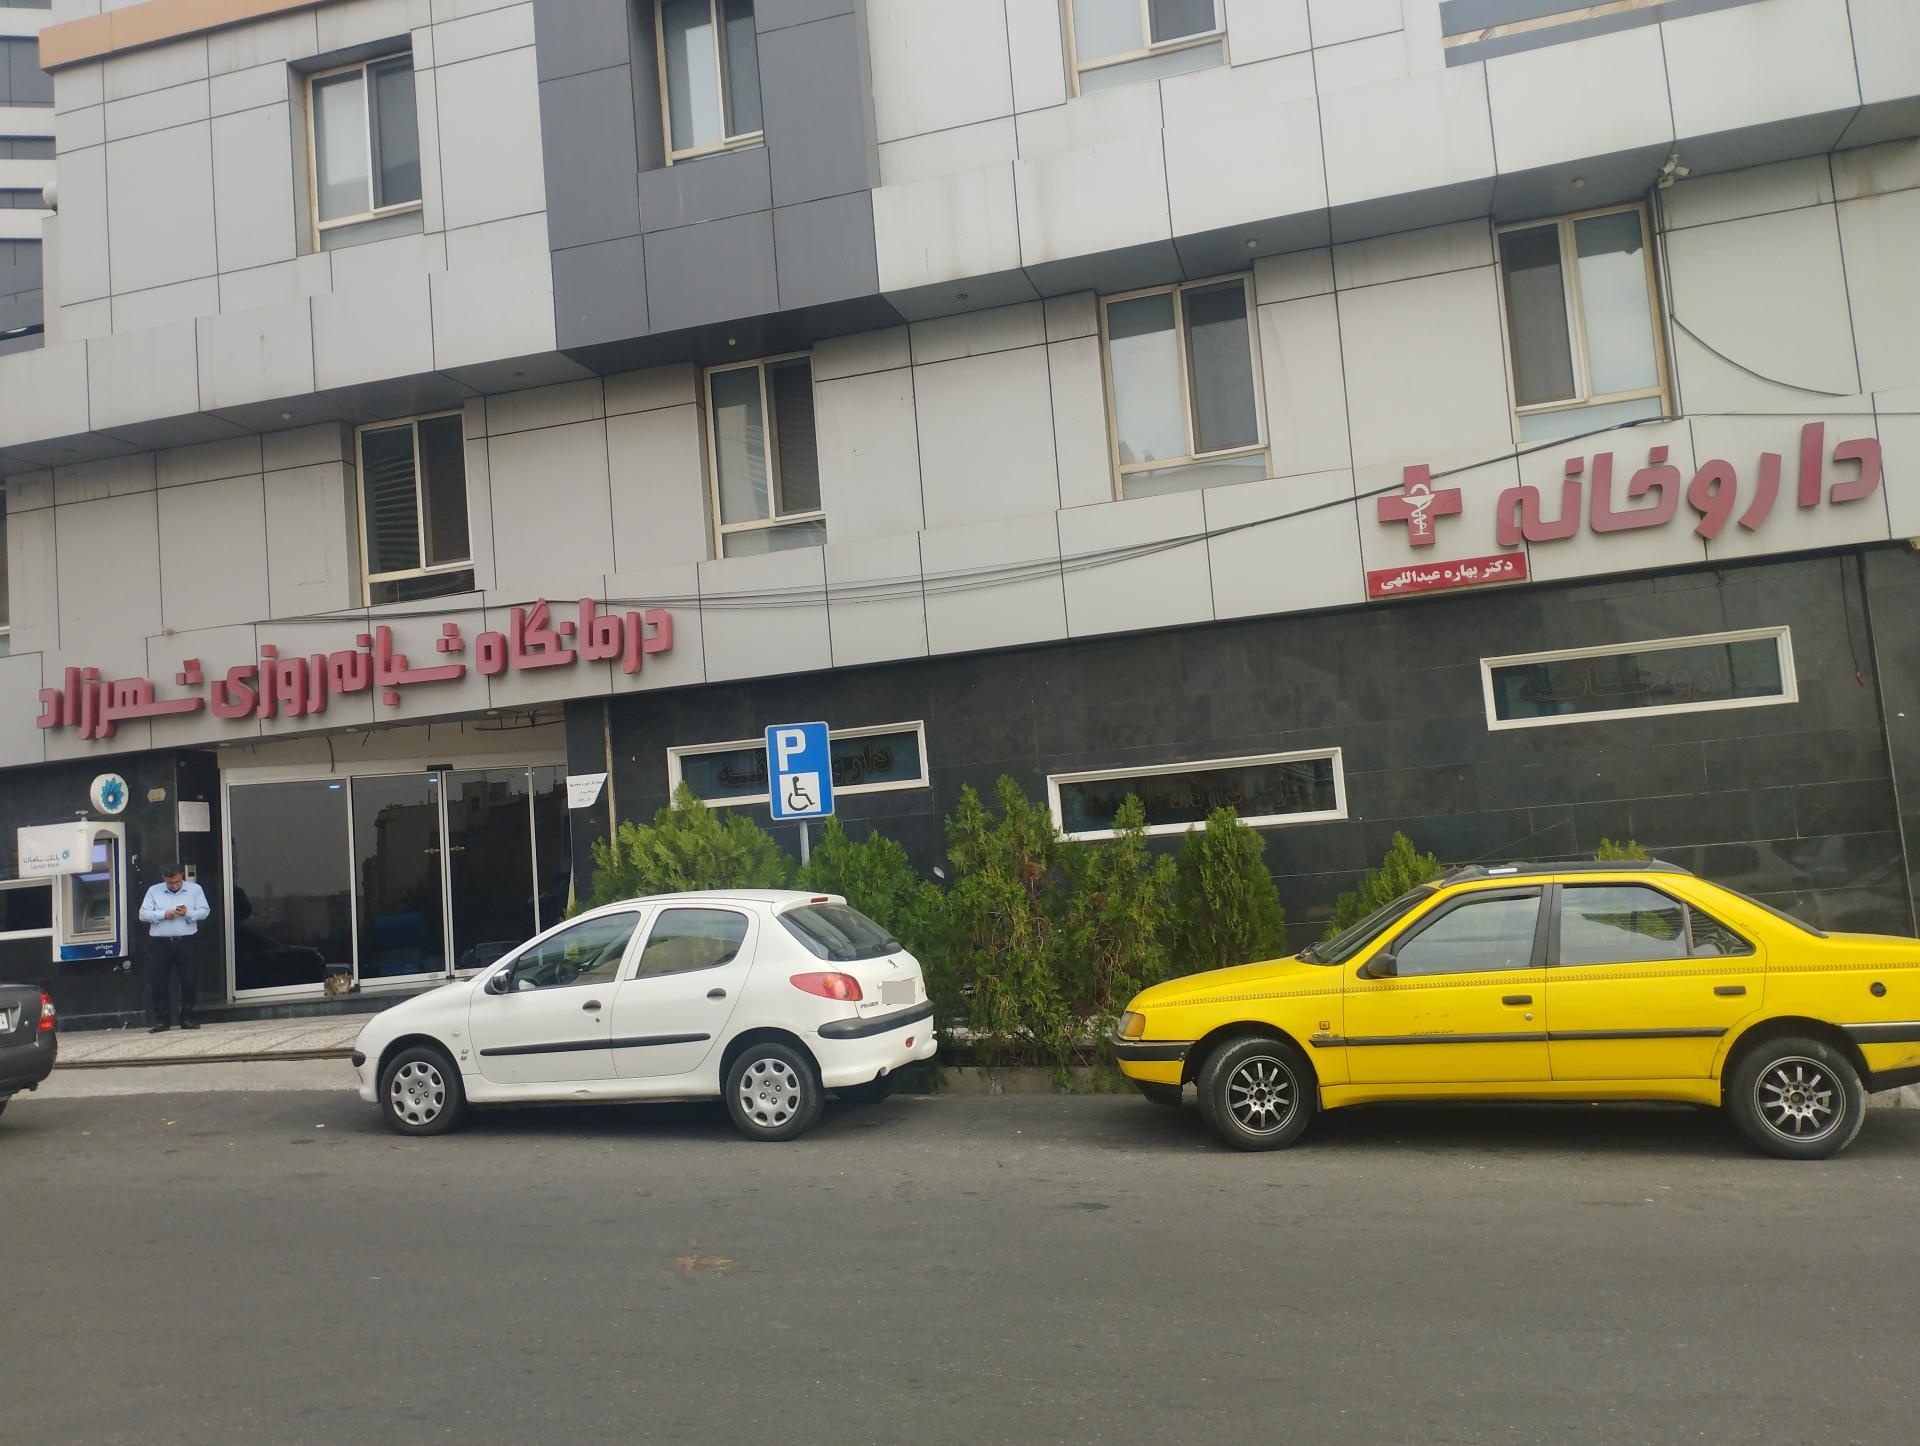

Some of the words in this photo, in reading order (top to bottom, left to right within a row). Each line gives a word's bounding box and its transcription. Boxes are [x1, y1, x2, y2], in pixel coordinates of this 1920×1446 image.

[1496, 422, 1882, 547] داروخانه
[1380, 569, 1441, 590] عبداللهی
[1444, 564, 1478, 582] بهاره
[1482, 558, 1514, 578] دکتر
[475, 597, 673, 675] درمانگاه
[36, 657, 205, 741] شهرزاد
[775, 729, 806, 772] P
